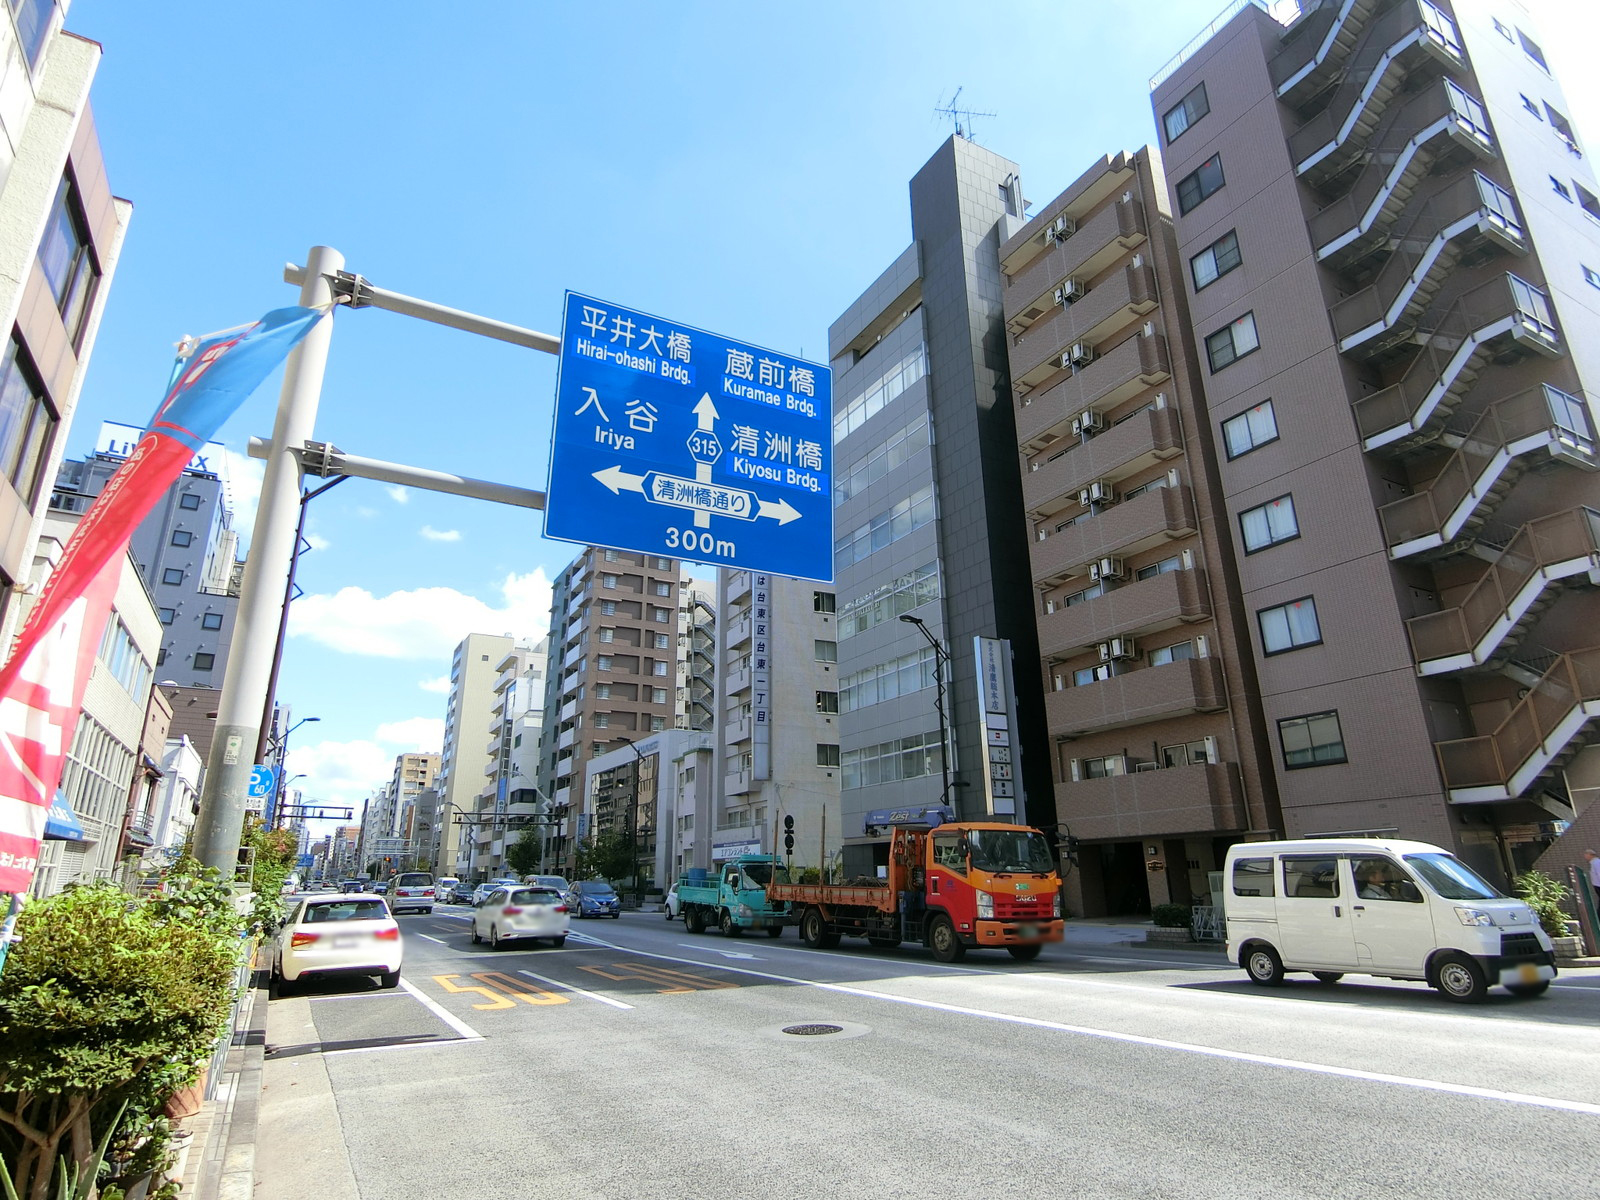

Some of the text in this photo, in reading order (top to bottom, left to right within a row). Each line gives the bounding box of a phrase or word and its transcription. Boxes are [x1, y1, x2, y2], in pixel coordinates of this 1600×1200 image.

[580, 305, 692, 364] 平井大橋
[576, 338, 692, 385] Hirai-ohashi Brdg.
[724, 348, 815, 398] 蔵前橋
[574, 386, 659, 433] 入谷
[723, 377, 817, 418] Kuramae Brdg.
[594, 425, 635, 451] Iriya
[691, 437, 717, 457] 315
[730, 423, 823, 472] 清洲橋
[733, 456, 821, 492] Kiyosu Brdg.
[656, 479, 746, 513] 清洲橋通り
[665, 526, 736, 559] 300m
[432, 972, 570, 1010] 50
